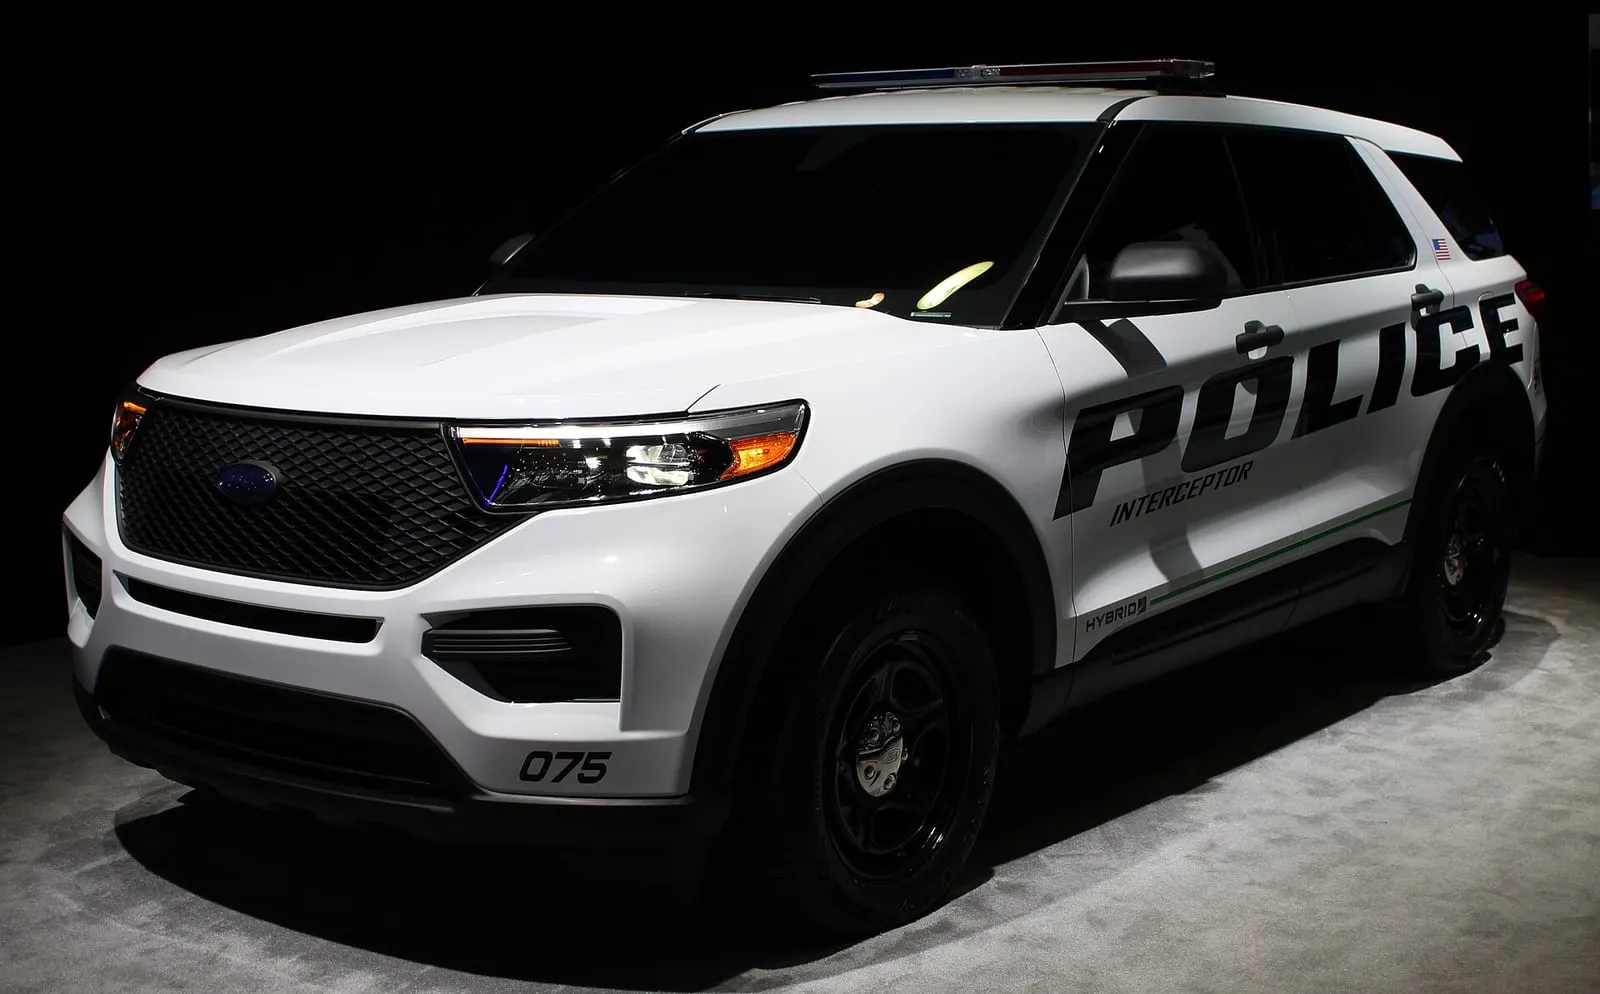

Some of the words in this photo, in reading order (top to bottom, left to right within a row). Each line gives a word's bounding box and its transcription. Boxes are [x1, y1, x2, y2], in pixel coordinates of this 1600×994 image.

[1053, 293, 1524, 521] POLICE
[1110, 460, 1254, 527] INTERCEPTOR
[1086, 602, 1137, 632] HYBRID
[519, 751, 613, 784] 075
